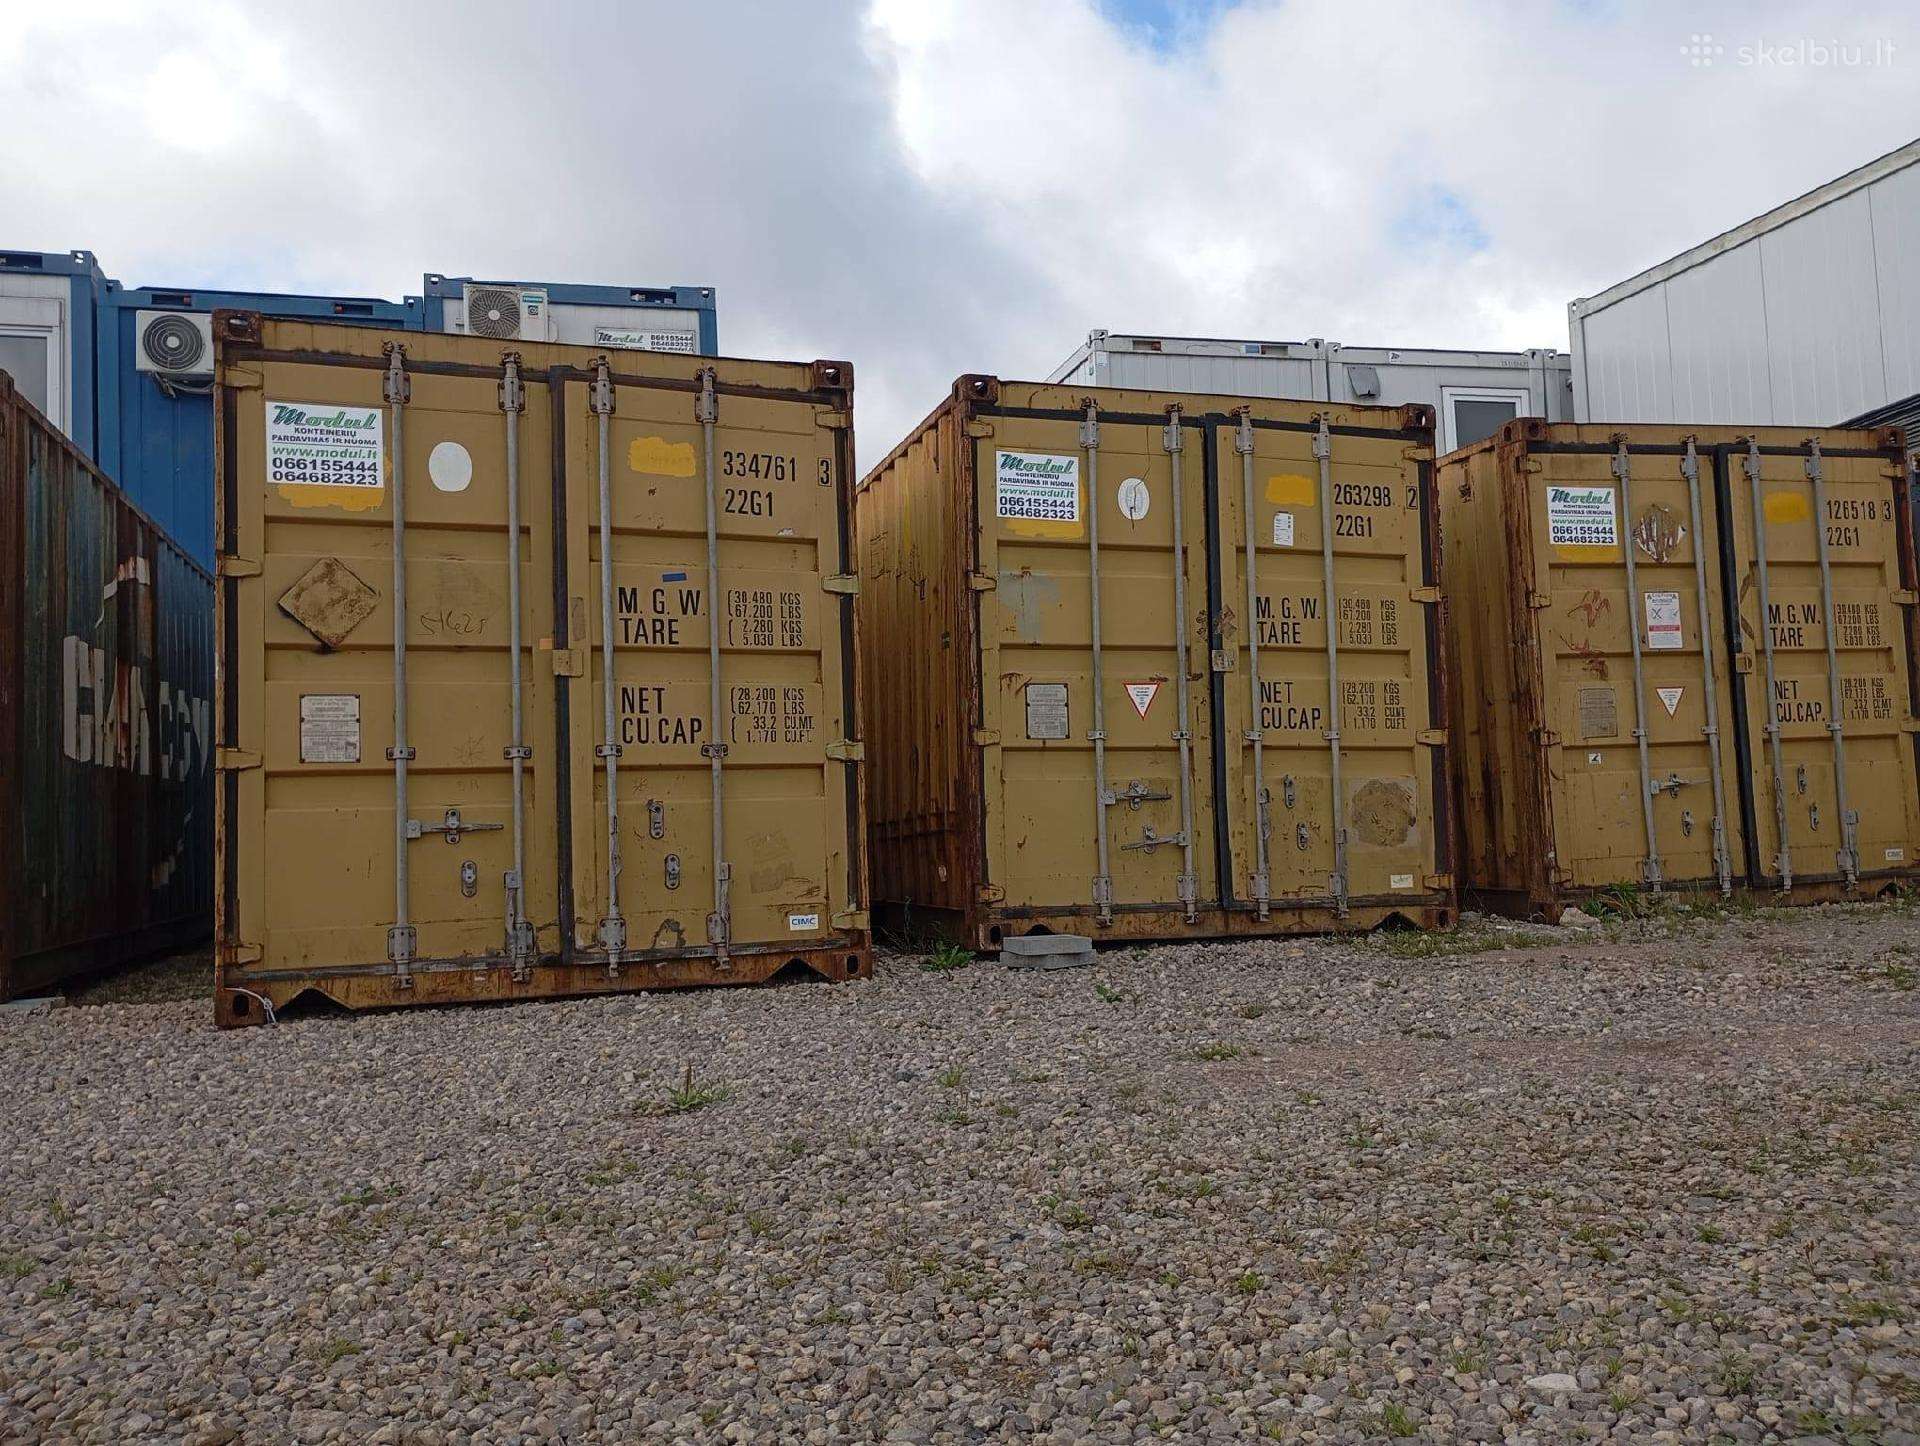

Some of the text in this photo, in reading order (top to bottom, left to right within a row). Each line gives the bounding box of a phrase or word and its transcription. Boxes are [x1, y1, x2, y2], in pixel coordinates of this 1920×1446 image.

[273, 405, 377, 430] Modul
[272, 434, 330, 443] PARDAVIMAS
[344, 438, 377, 446] NUOMA
[272, 446, 376, 460] www.modul.lt
[272, 457, 378, 473] 066155444
[724, 451, 830, 484] 334761 3
[1000, 454, 1075, 474] Modul
[273, 471, 377, 485] 064682323
[1000, 487, 1074, 498] www.modul.lt
[1334, 484, 1417, 508] 263298 2
[1551, 489, 1611, 504] Modul
[725, 489, 773, 516] 22G1
[1000, 496, 1075, 509] 066155444
[1000, 506, 1074, 520] 064682323
[1827, 500, 1891, 521] 126518 3
[1335, 514, 1372, 538] 22G1
[1552, 518, 1612, 526] www.modul.lt
[1553, 526, 1613, 535] 066155444
[1827, 527, 1860, 546] 22G1
[1553, 535, 1613, 544] 064682323
[781, 592, 800, 605] KGS
[781, 606, 801, 619] LBS
[1381, 611, 1396, 622] LBS
[619, 618, 679, 645] TARE
[782, 620, 801, 634] KGS
[1256, 621, 1301, 645] TARE
[782, 634, 802, 646] LBS
[1383, 634, 1397, 645] LBS
[1770, 627, 1804, 647] TARE
[739, 687, 804, 701] 28.200 KGS
[1260, 682, 1294, 704] NET
[1384, 682, 1399, 694] KGS
[1774, 680, 1799, 700] NET
[621, 687, 665, 714] NET
[1384, 694, 1399, 705] LBS
[739, 701, 804, 714] 62.170 LBS
[1776, 702, 1826, 723] CU.CAP.
[754, 716, 776, 729] 33.2
[1261, 707, 1323, 730] CU.CAP.
[622, 717, 705, 745] CU.CAP.
[792, 917, 815, 927] CIMC
